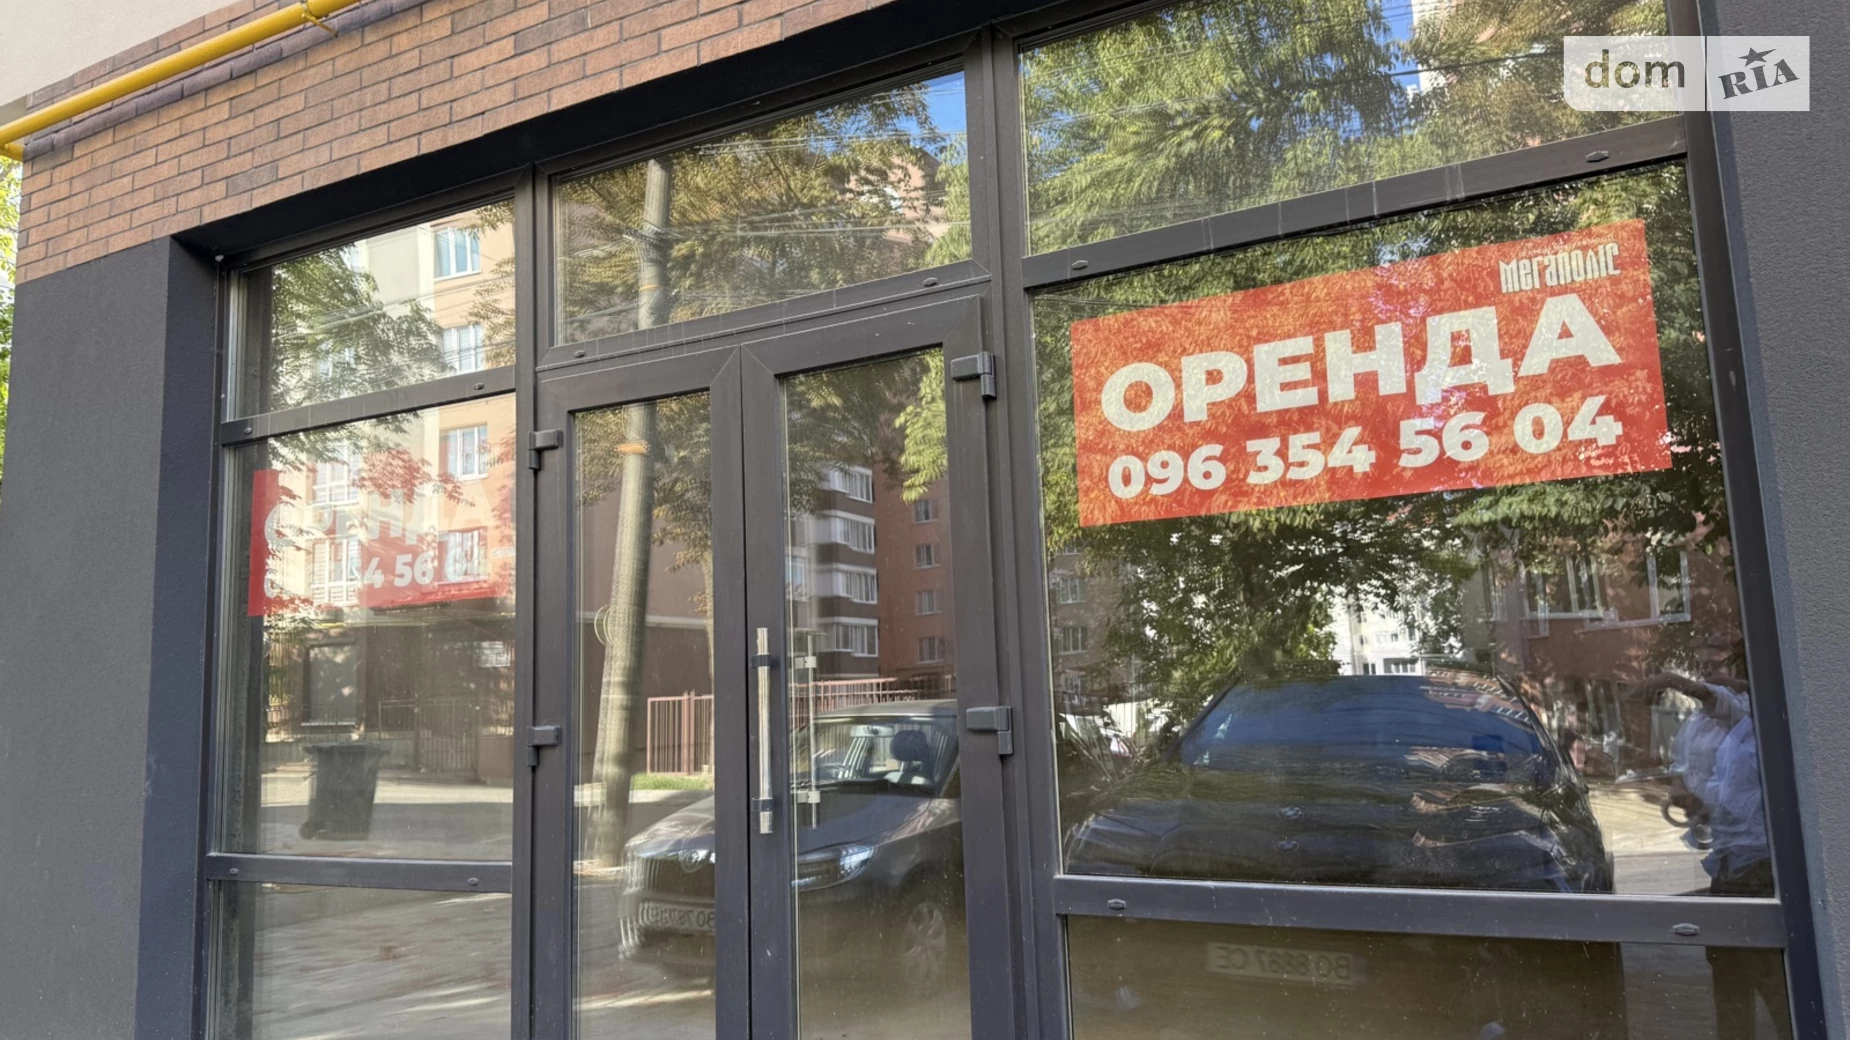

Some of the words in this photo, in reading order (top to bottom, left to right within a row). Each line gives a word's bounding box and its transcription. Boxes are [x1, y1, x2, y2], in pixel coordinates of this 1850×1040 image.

[1101, 294, 1622, 431] ОРЕНДА
[1108, 444, 1227, 499] 096
[1247, 427, 1376, 485] 354
[1398, 411, 1489, 467] 56
[1513, 395, 1623, 454] 04
[394, 552, 434, 587] 56
